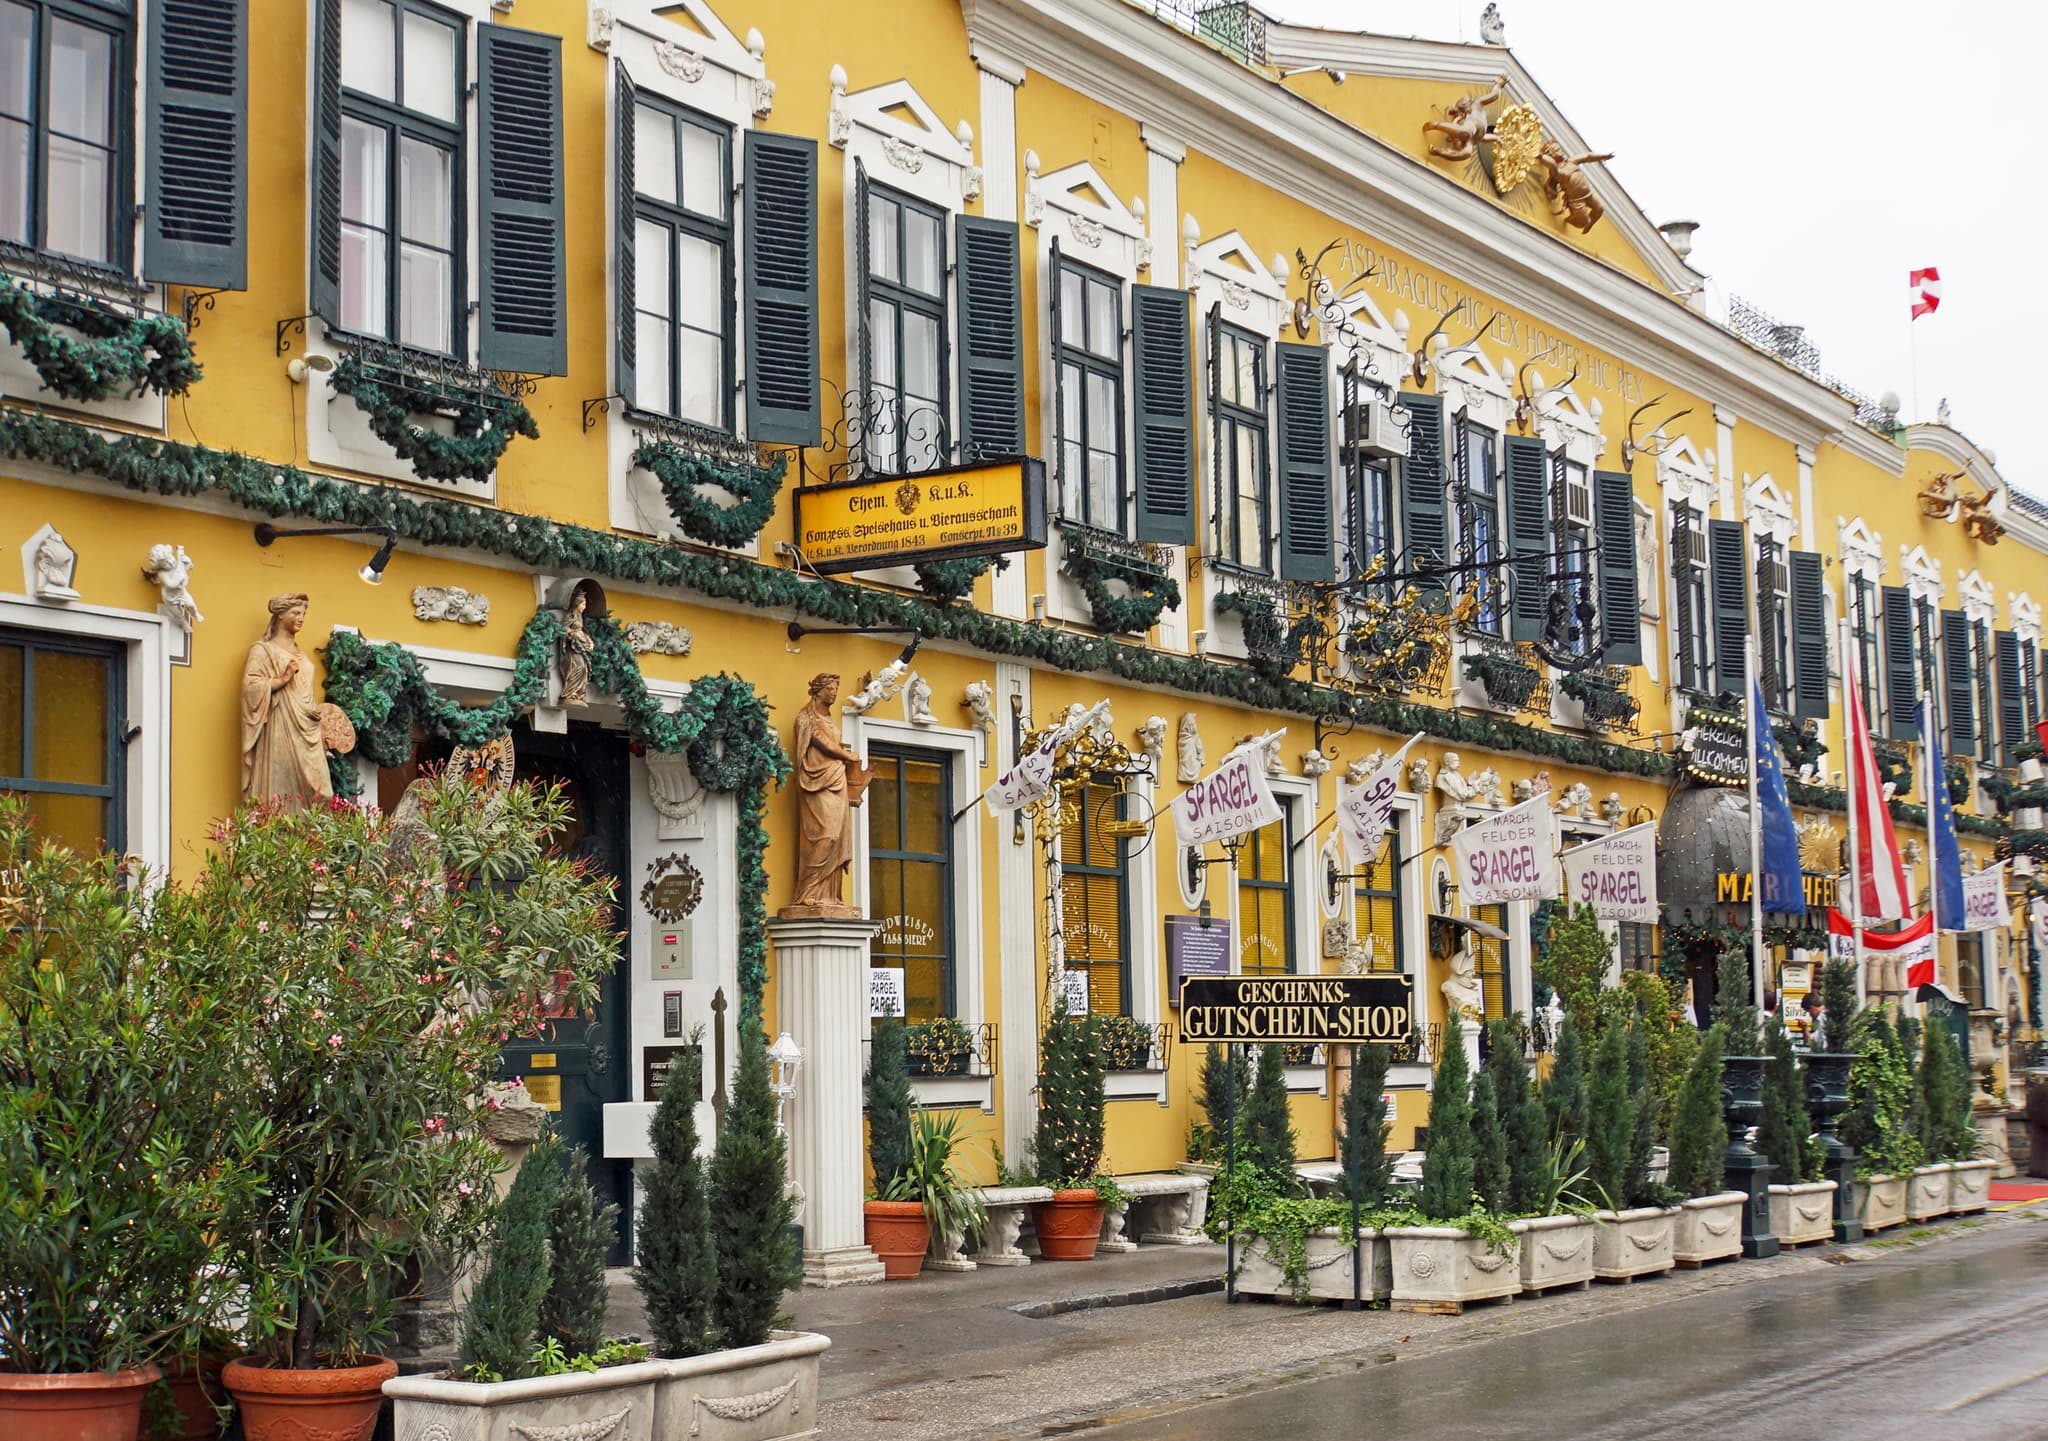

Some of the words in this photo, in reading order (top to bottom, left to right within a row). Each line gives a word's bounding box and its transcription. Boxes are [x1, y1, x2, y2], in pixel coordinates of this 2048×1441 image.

[1341, 239, 1449, 315] ASPARAGUS
[1455, 291, 1486, 329] HIC
[1490, 307, 1520, 351] LEX
[1526, 324, 1582, 377] HOSPES
[1586, 354, 1612, 392] HIC
[1617, 367, 1646, 402] REX
[849, 495, 888, 513] Ehem.
[853, 519, 917, 539] Speisehaus
[930, 505, 1017, 527] Bierausschank
[847, 540, 899, 555] Verordnung
[901, 535, 926, 549] 1843
[1003, 523, 1018, 536] 39
[1185, 763, 1258, 822] SPARGEL
[1482, 827, 1536, 843] FELDER
[1469, 845, 1540, 886] SPARGEL
[1593, 854, 1643, 865] FELDER
[1581, 870, 1647, 905] SPARGEL
[874, 915, 934, 940] BUDWEISER
[871, 997, 901, 1012] PARGEL
[1238, 982, 1350, 1004] GESCHENKS-
[1185, 1006, 1407, 1037] GUTSCHEIN-SHOP
